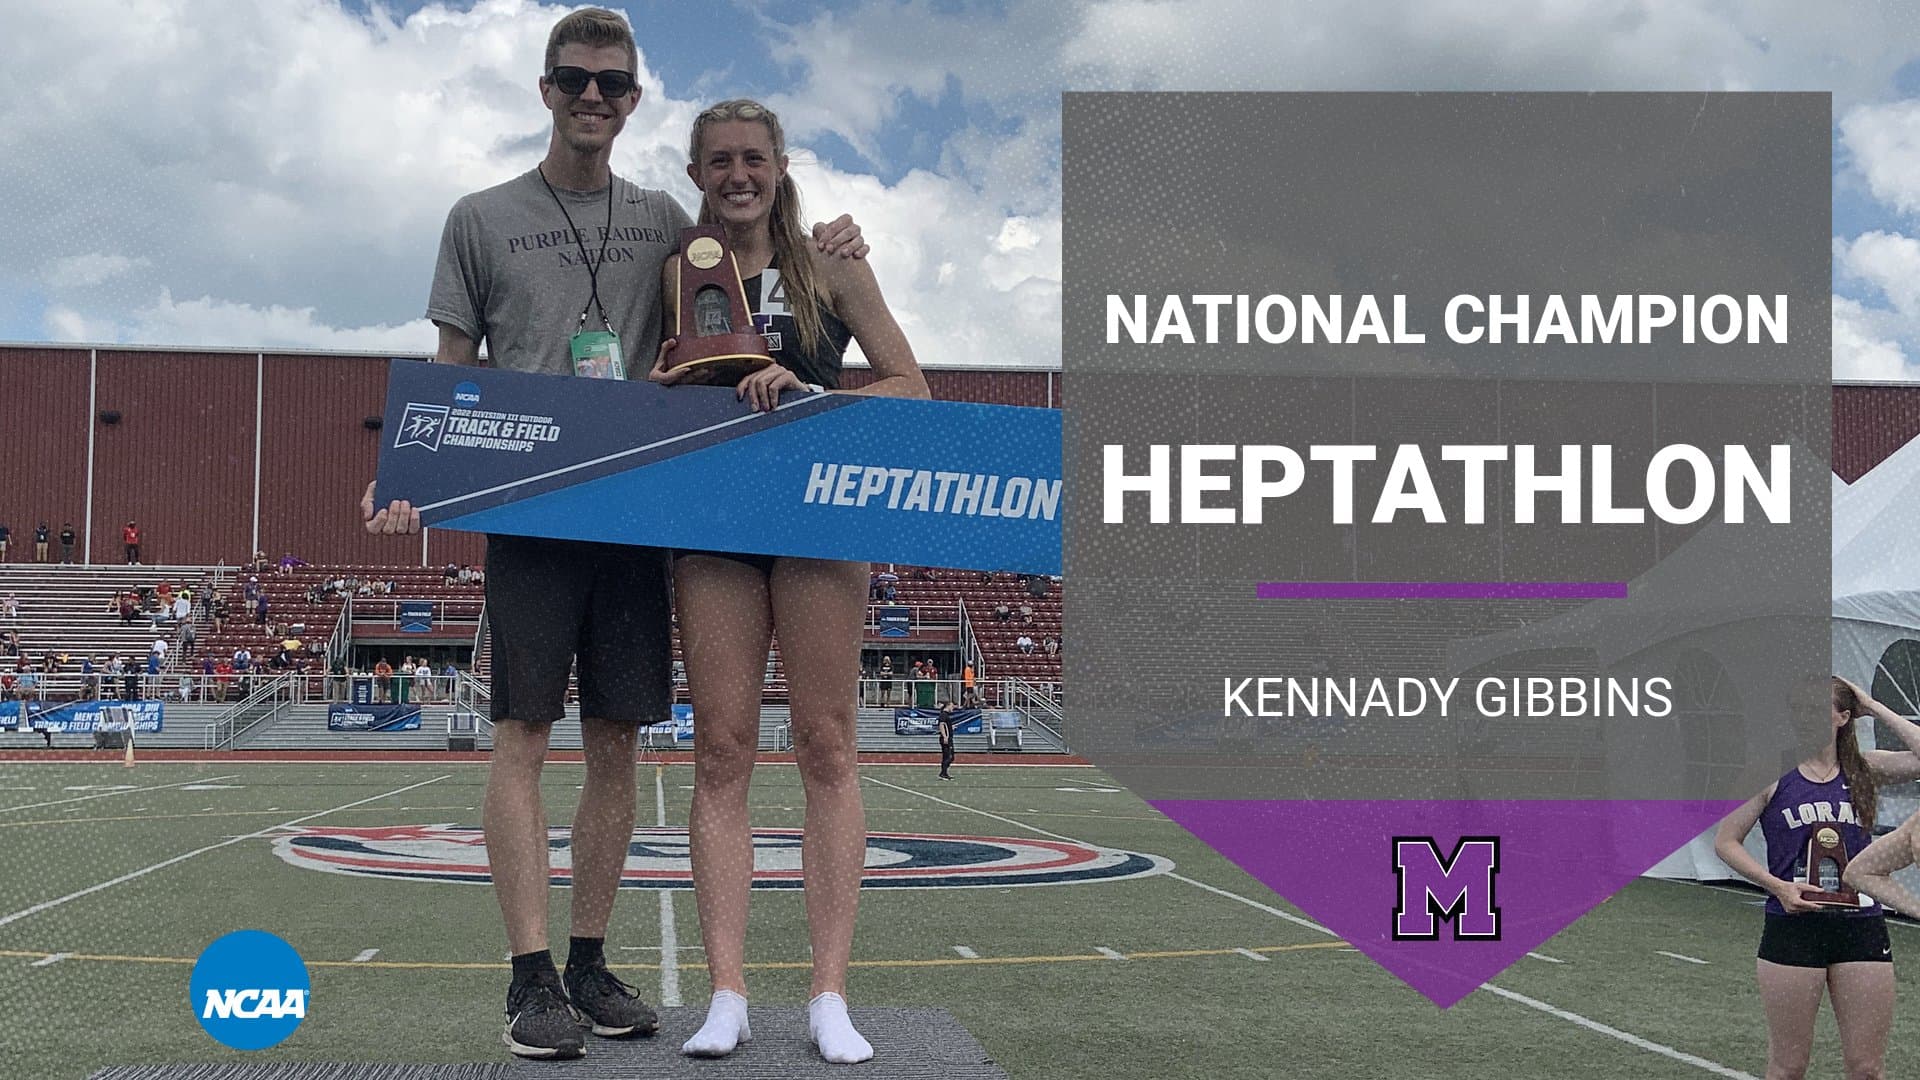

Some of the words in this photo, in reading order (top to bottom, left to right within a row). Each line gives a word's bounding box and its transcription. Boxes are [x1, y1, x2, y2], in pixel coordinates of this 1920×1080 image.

[508, 228, 590, 253] PURPLE
[597, 226, 667, 244] RAIDER
[558, 247, 635, 268] NATION
[454, 393, 480, 402] NCAA
[451, 409, 471, 417] 2022
[471, 410, 506, 419] DIVISION
[519, 414, 553, 424] OUTDOOR
[448, 417, 501, 437] TRACK
[501, 421, 515, 438] &
[515, 422, 561, 442] FIELD
[443, 435, 535, 452] CHAMPIONSHIPS
[803, 462, 1063, 521] HEPTATHLON
[69, 721, 92, 730] FIELD
